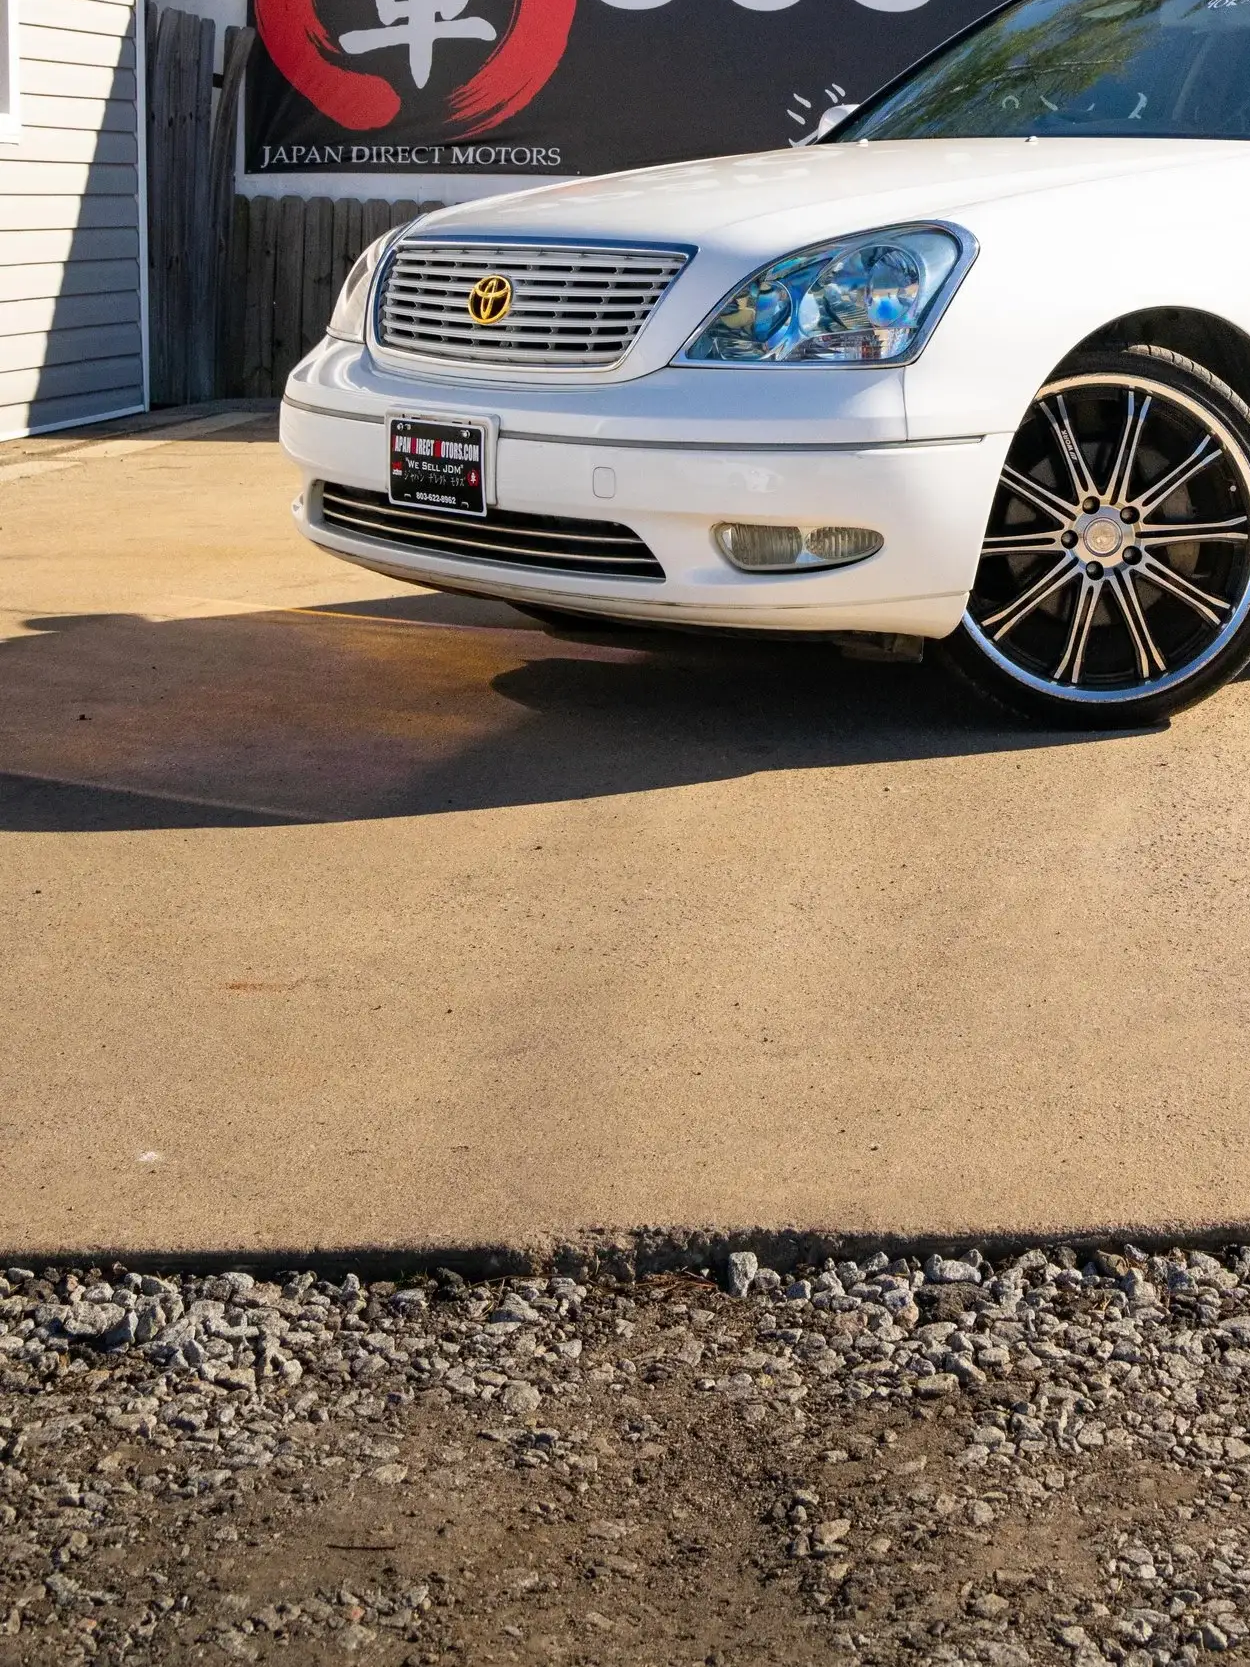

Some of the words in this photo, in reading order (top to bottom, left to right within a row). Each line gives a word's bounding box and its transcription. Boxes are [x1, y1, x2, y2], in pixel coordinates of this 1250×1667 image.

[260, 145, 343, 169] JAPAN
[350, 145, 445, 165] DIRECT
[451, 146, 562, 167] MOTORS
